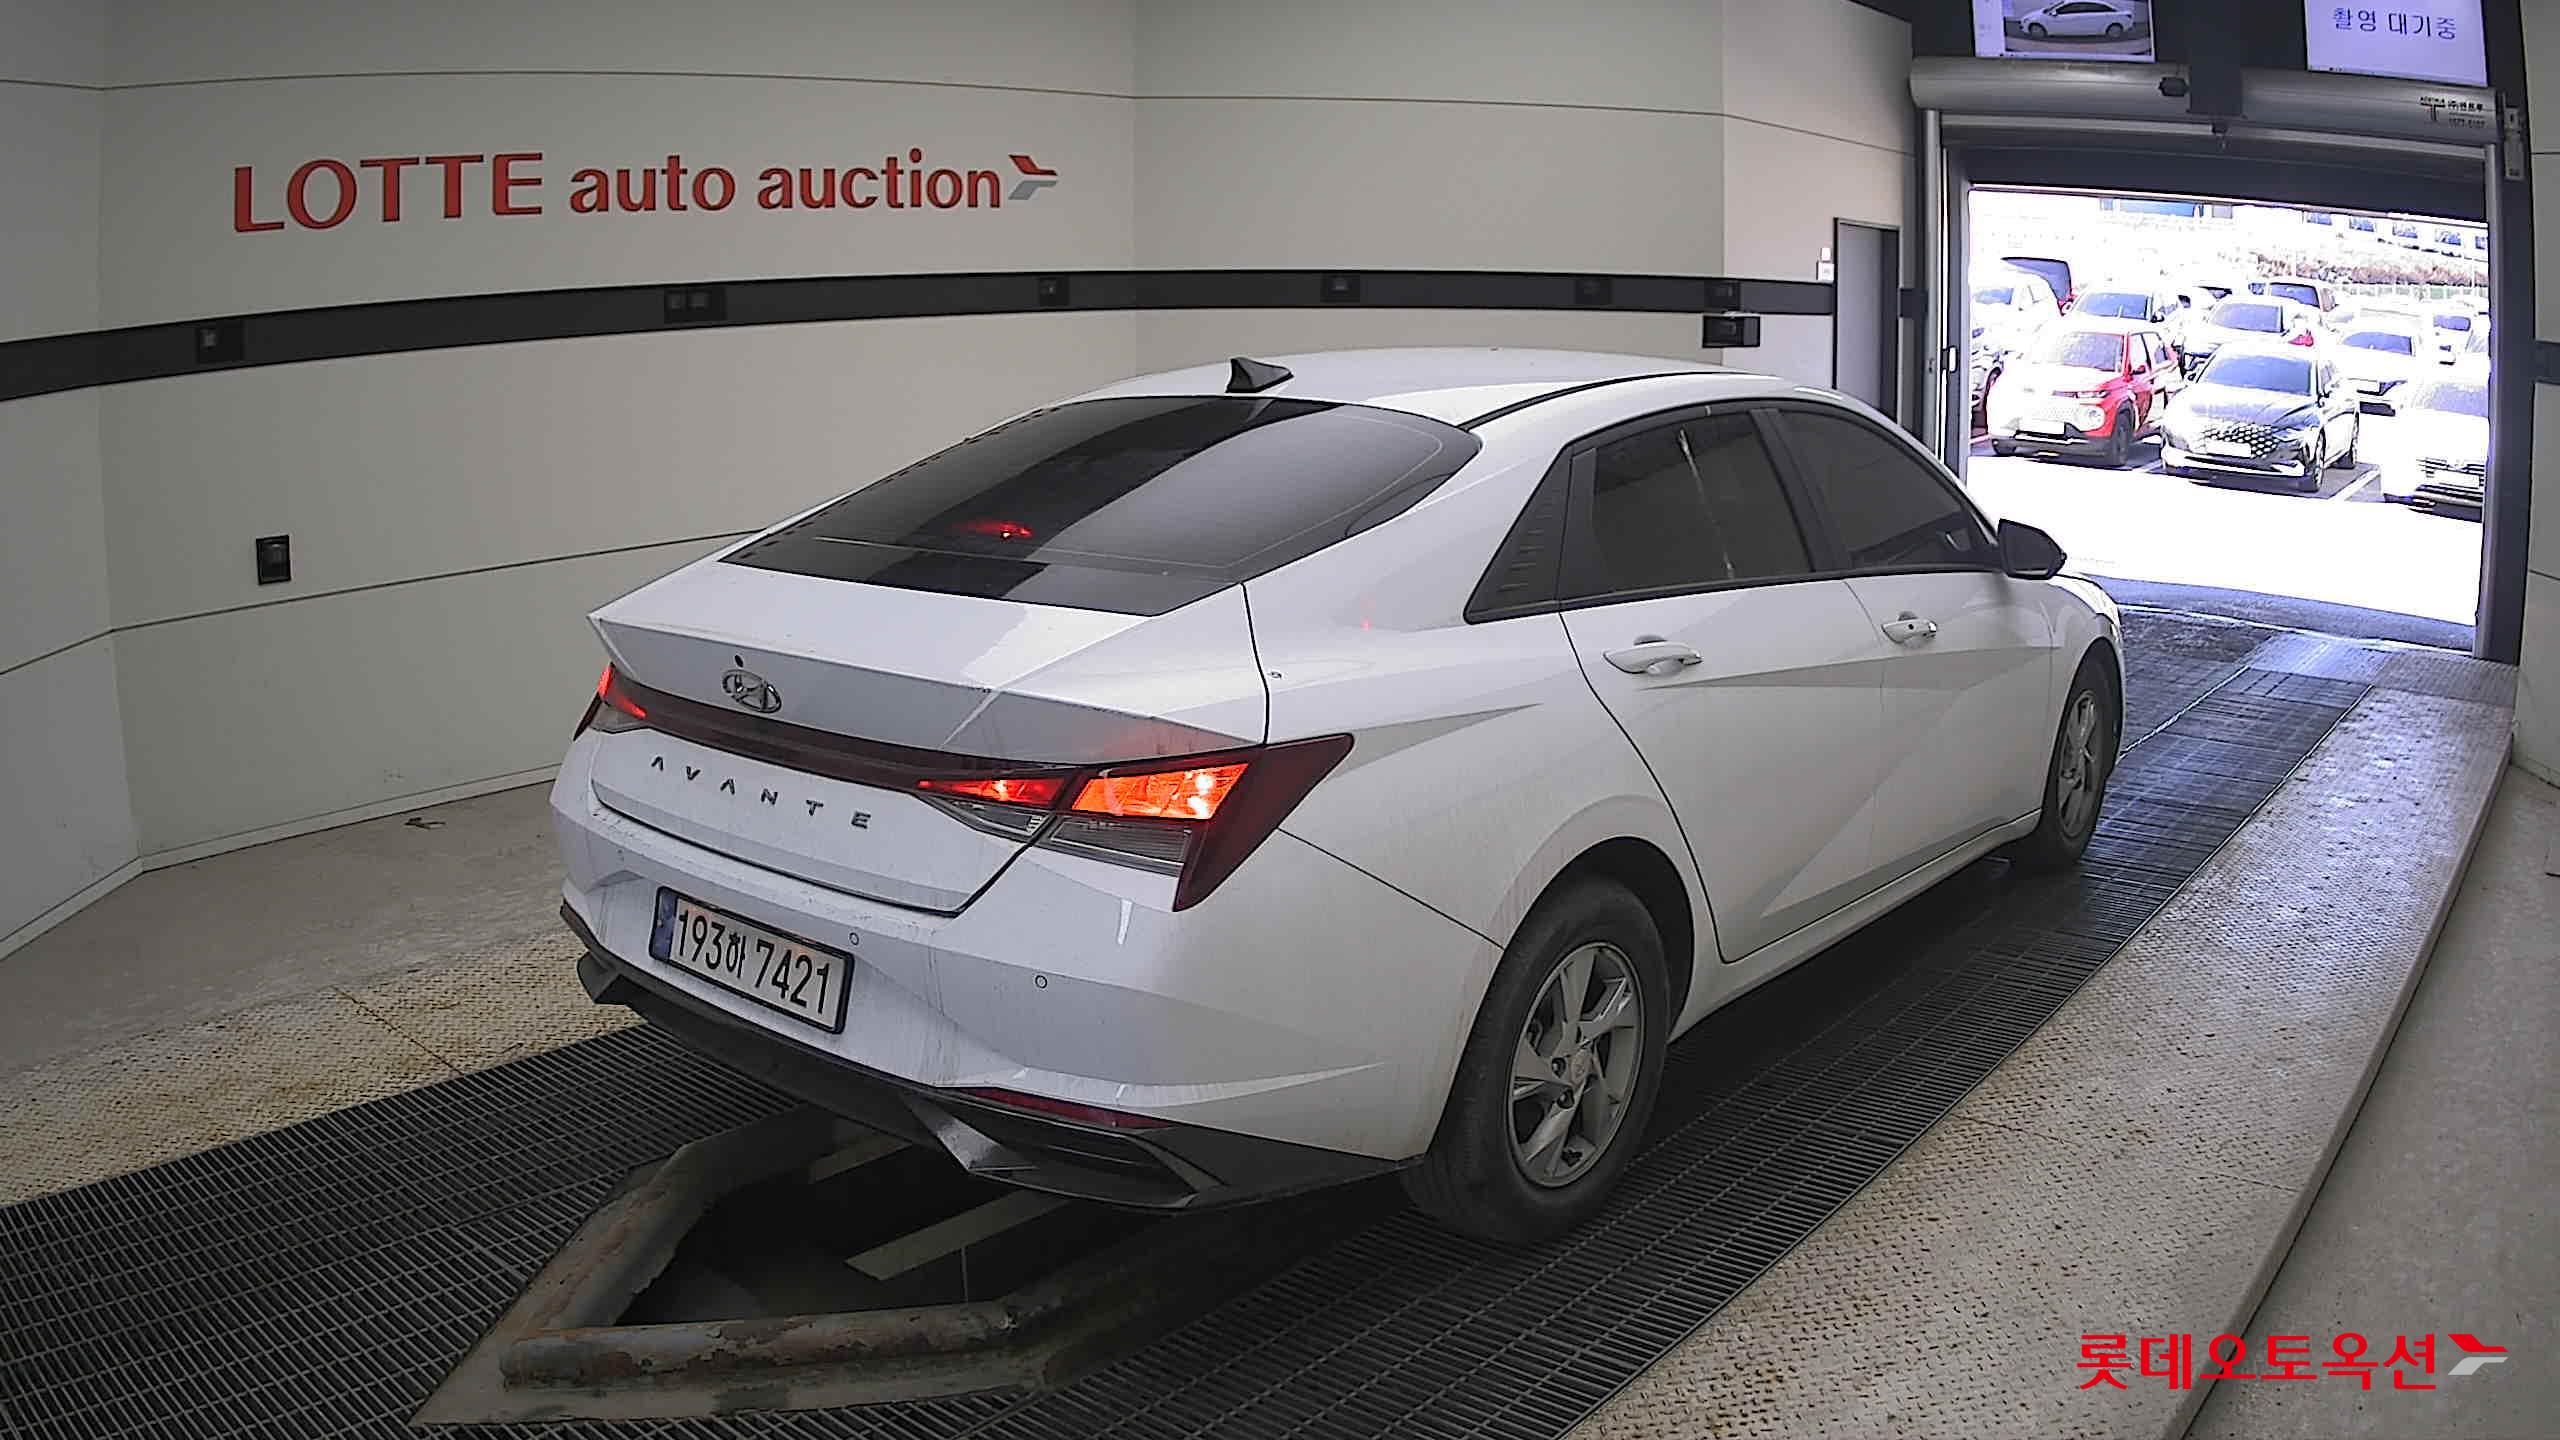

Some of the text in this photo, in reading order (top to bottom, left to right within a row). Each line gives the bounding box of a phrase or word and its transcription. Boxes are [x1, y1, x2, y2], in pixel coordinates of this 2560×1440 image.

[2333, 8, 2456, 40] 촬영 대기중
[234, 148, 1000, 232] LOTTE auto auction
[651, 756, 871, 829] AVANTE
[755, 939, 830, 1014] 7421
